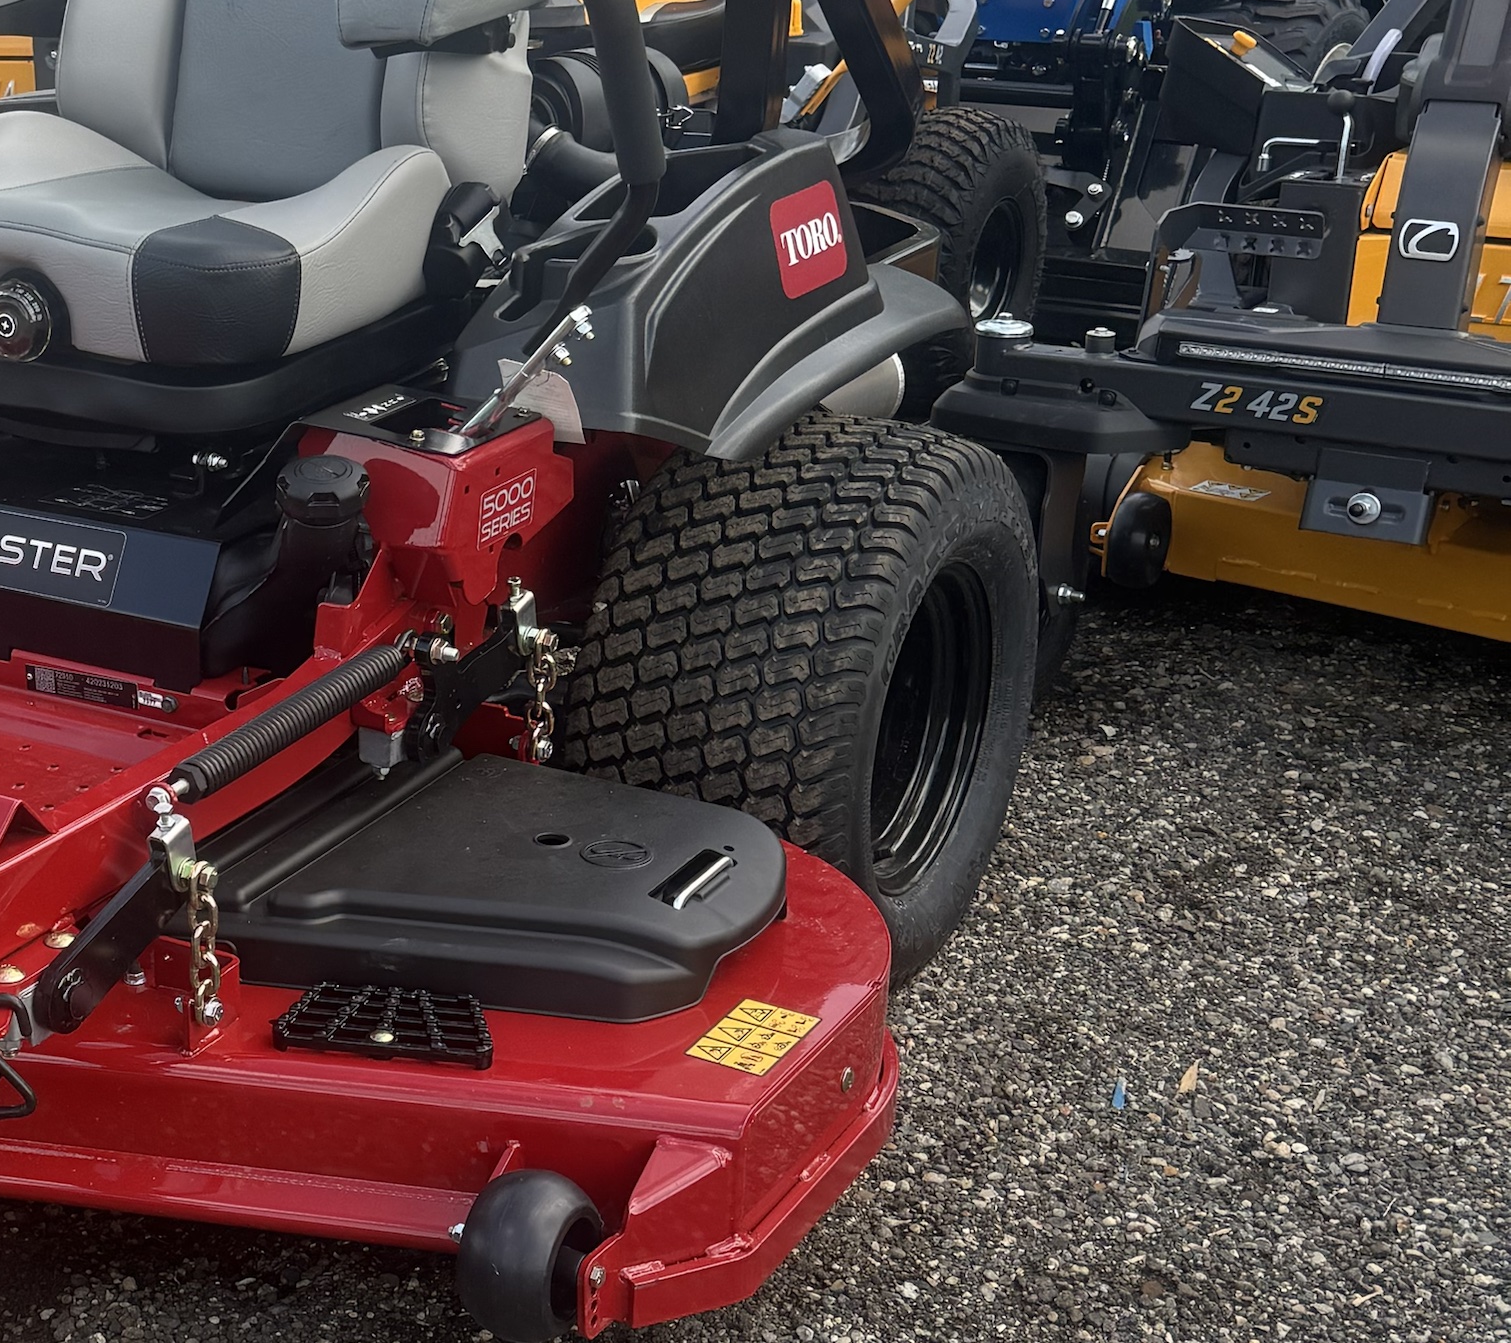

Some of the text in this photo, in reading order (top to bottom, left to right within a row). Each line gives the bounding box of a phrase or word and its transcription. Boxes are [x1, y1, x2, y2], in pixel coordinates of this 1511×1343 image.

[779, 211, 839, 267] TORO
[1190, 382, 1323, 424] Z2 42S
[482, 476, 534, 520] 5000
[480, 501, 532, 543] SERIES
